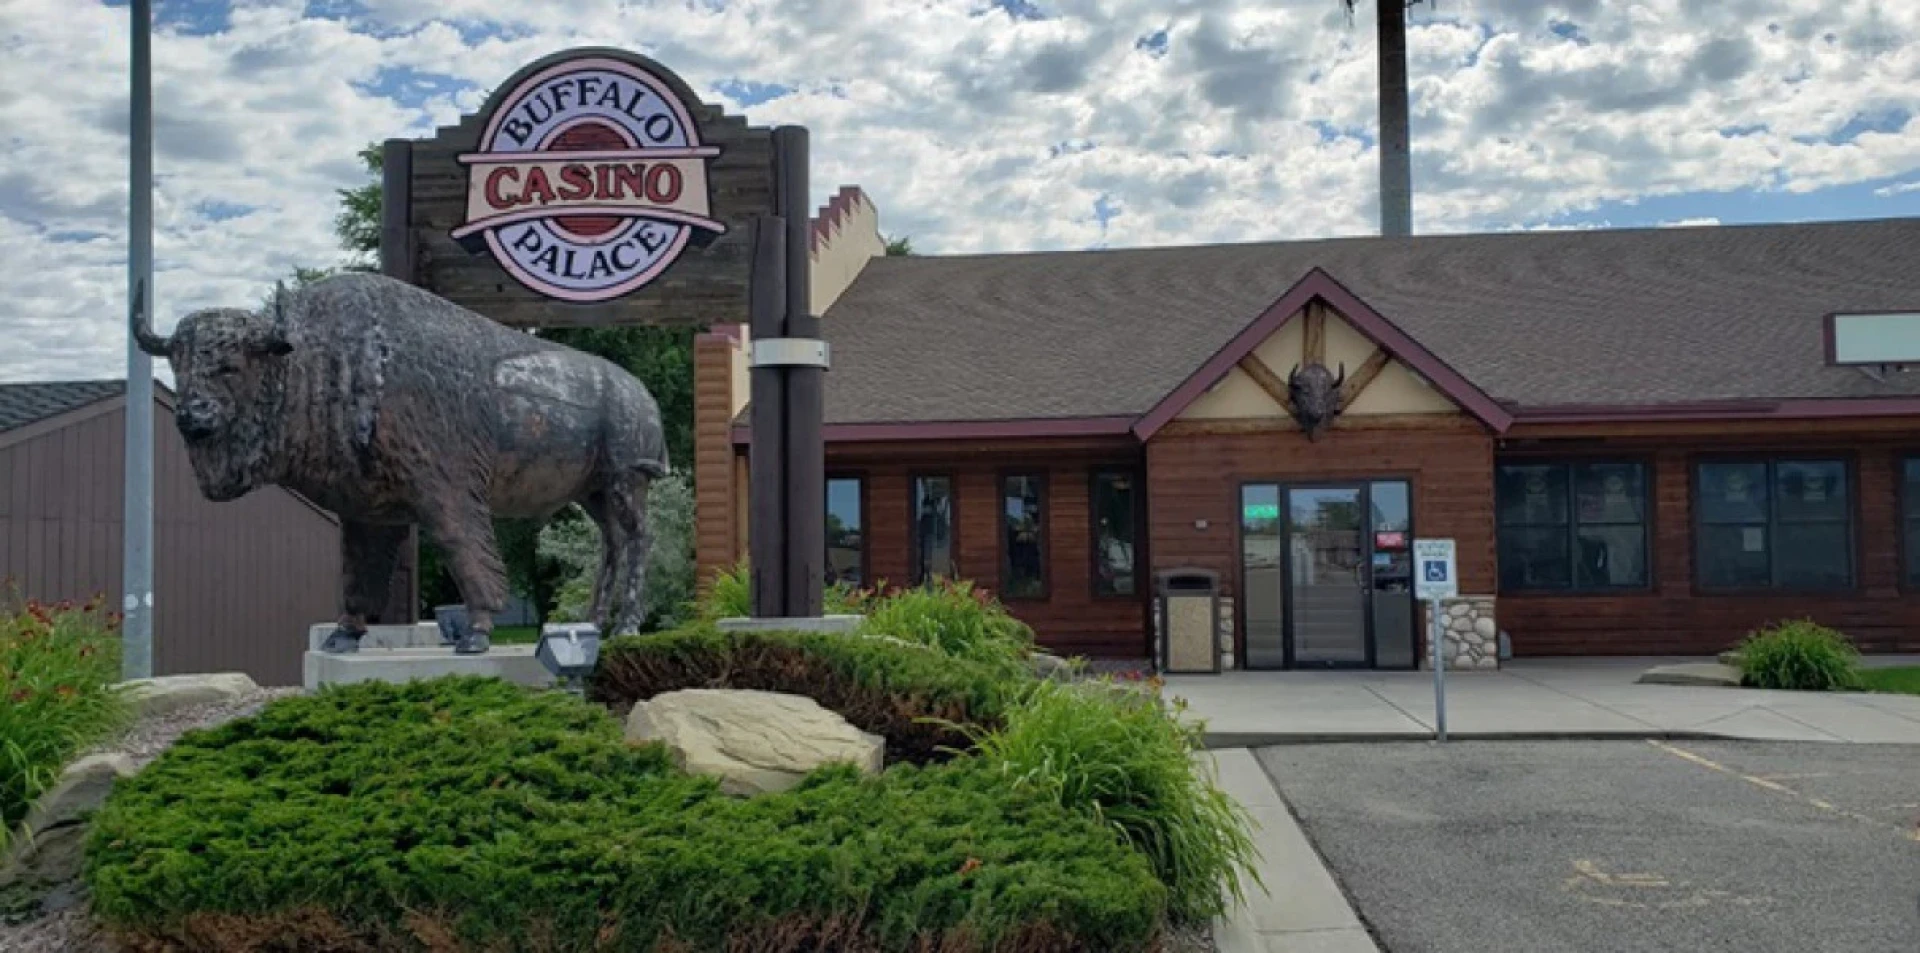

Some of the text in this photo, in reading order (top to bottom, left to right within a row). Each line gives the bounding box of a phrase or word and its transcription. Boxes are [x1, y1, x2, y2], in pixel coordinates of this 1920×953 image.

[502, 77, 674, 147] BUFFALO
[484, 163, 683, 210] CASINO
[513, 223, 667, 280] PALACE
